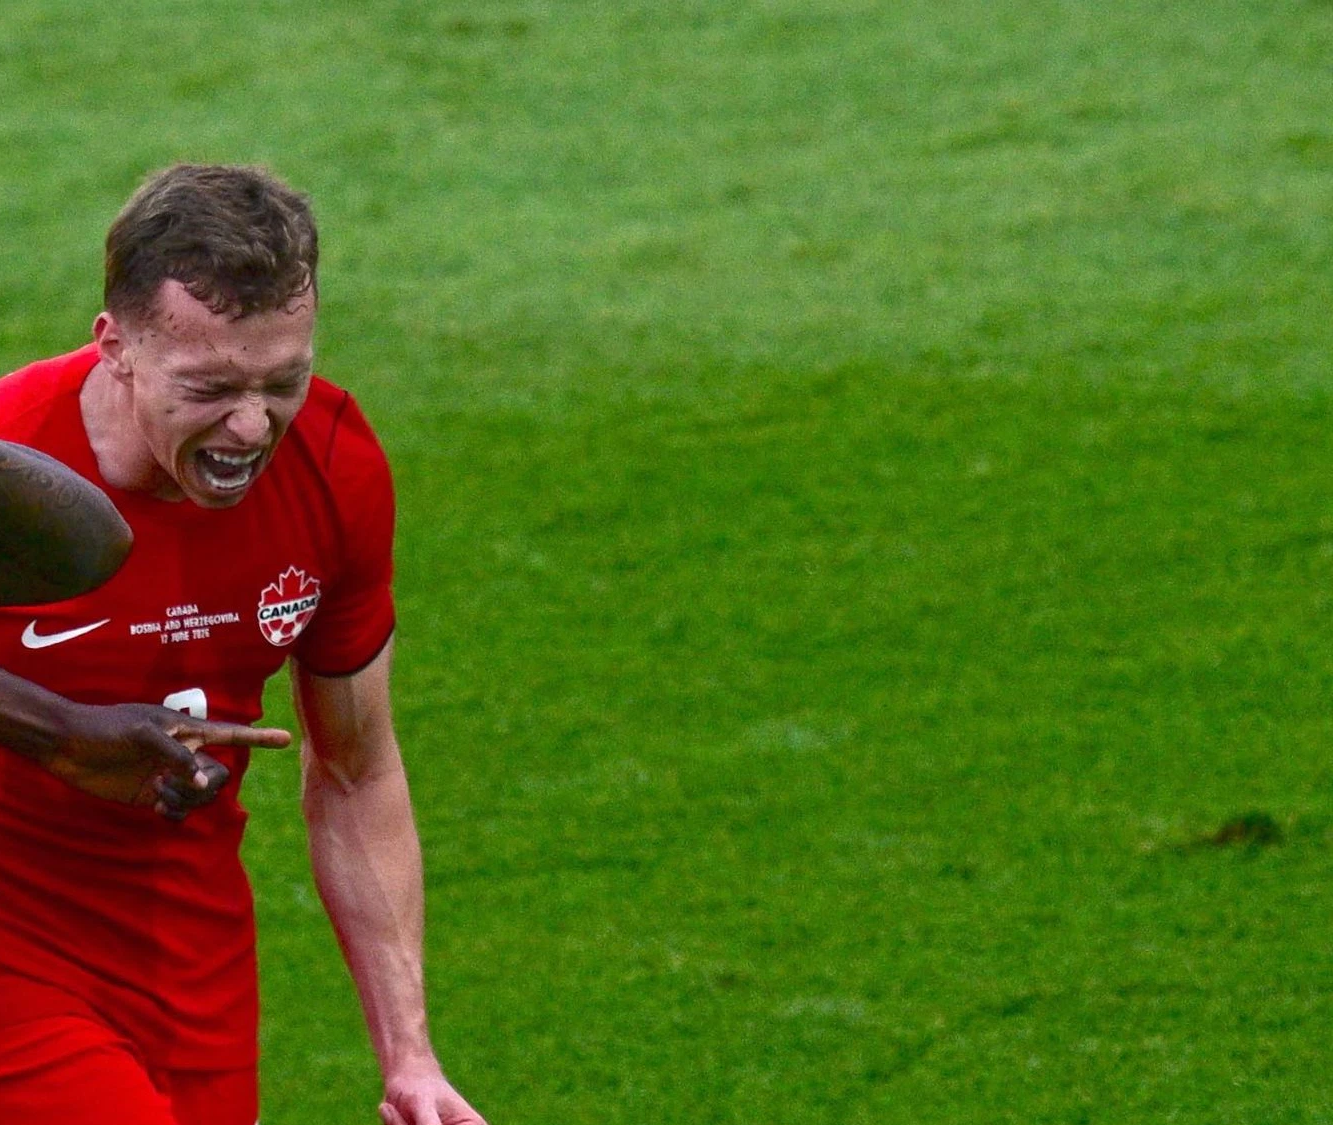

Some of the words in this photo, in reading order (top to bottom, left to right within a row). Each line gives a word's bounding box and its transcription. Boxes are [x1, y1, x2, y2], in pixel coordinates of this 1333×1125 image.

[165, 604, 199, 617] CANADA
[259, 597, 318, 620] CANADA
[130, 622, 161, 635] BOSNIA
[164, 619, 181, 631] AND
[183, 612, 240, 628] HERZEGOVINA
